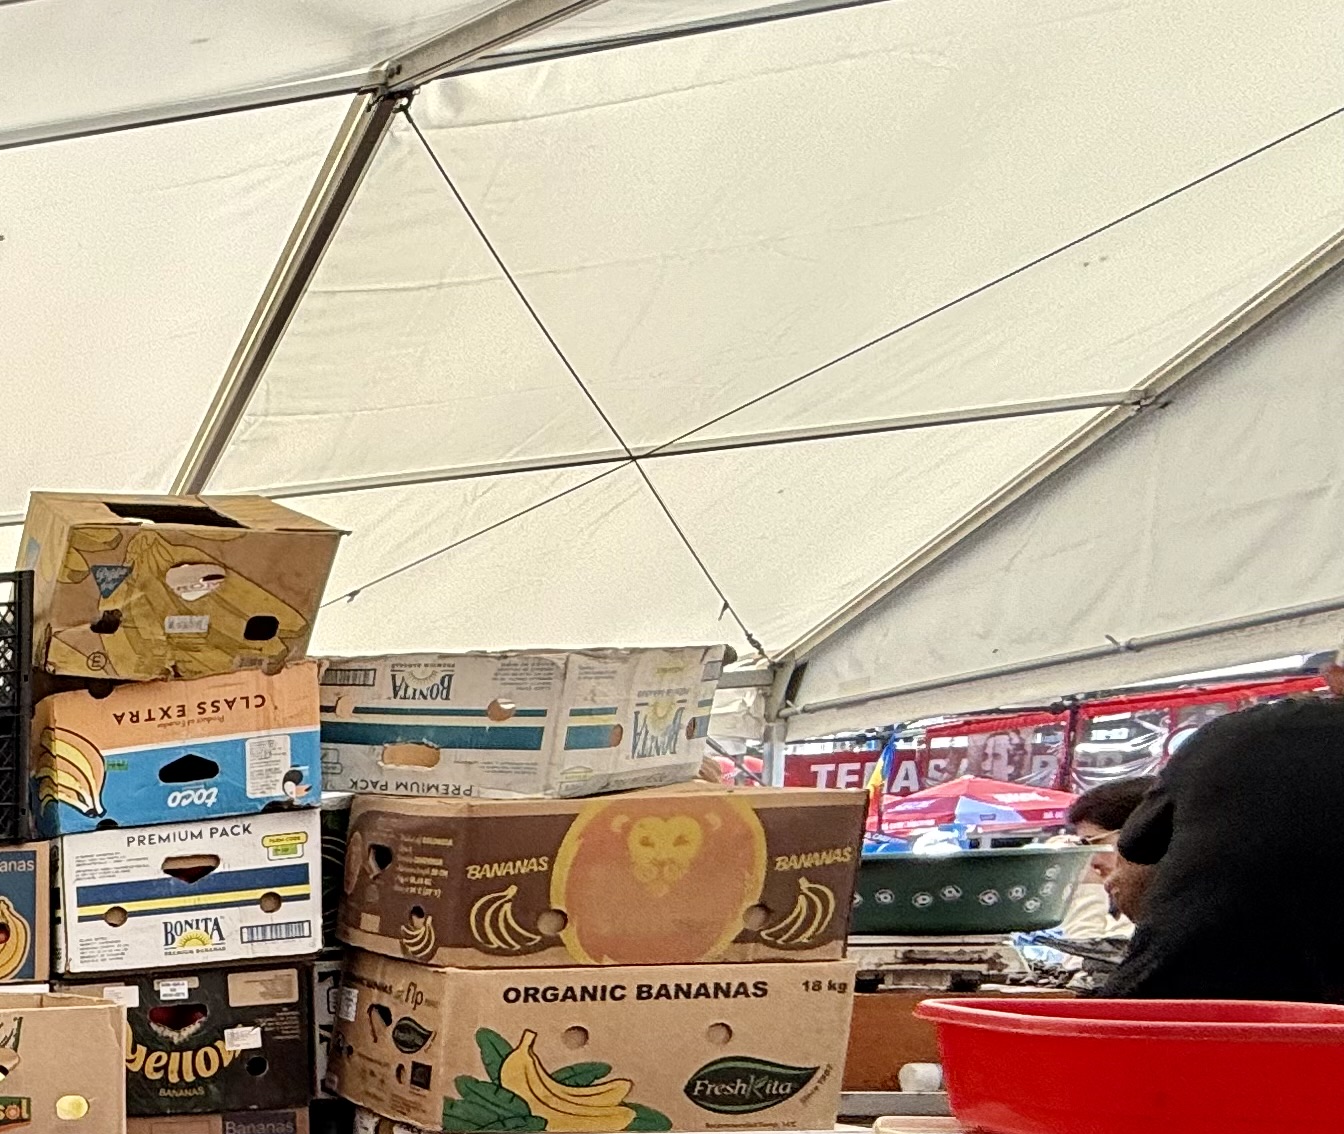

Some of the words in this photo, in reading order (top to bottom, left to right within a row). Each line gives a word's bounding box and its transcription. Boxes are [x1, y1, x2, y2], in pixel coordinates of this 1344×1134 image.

[390, 673, 454, 701] BONITA
[112, 704, 187, 726] EXTRA
[196, 694, 267, 716] CLASS
[349, 777, 388, 793] PACK
[395, 781, 474, 797] PREMIUM
[167, 786, 219, 808] toco
[126, 827, 204, 848] PREMIUM
[209, 822, 253, 839] PACK
[466, 855, 550, 880] BANANAS
[774, 846, 852, 873] BANANAS
[163, 917, 226, 947] BONITA
[503, 984, 627, 1004] ORGANIC
[636, 980, 769, 1001] BANANAS
[801, 979, 822, 994] 18
[827, 979, 849, 996] kg
[158, 1085, 206, 1098] BANANAS
